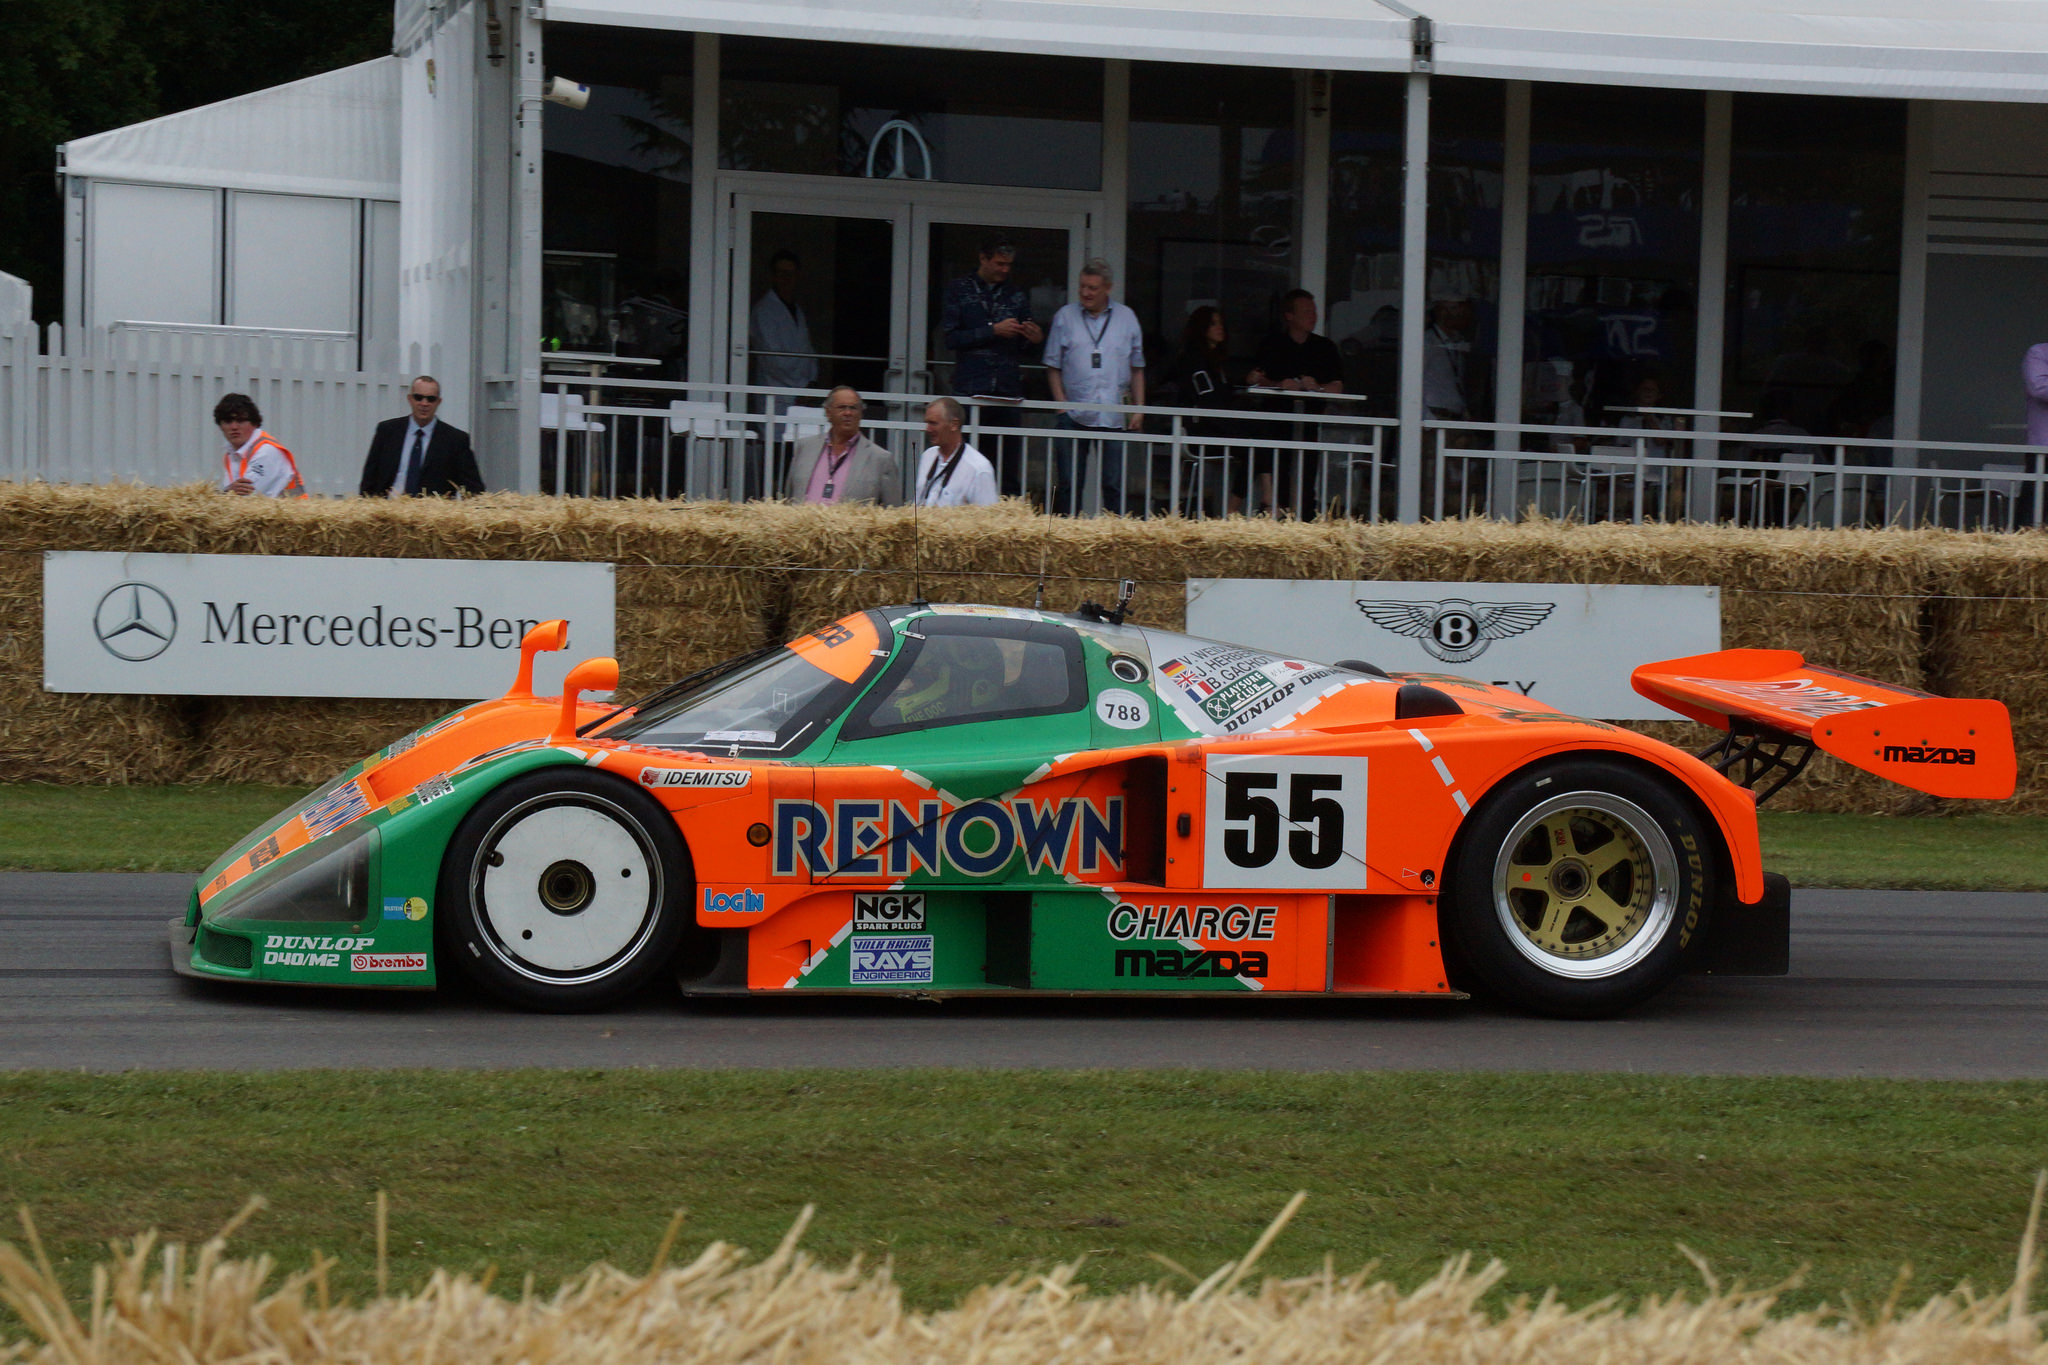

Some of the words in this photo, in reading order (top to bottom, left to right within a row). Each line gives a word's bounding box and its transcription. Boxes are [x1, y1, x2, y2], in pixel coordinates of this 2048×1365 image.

[202, 602, 570, 650] Mercedes-Ben
[1219, 670, 1264, 700] PLAYSURE
[1236, 682, 1262, 701] CLUB
[1105, 703, 1141, 722] 788
[1224, 682, 1295, 733] DUNLOP
[1884, 746, 1975, 765] mazda
[663, 771, 749, 786] IDEMITSU
[1224, 772, 1344, 869] 55
[772, 797, 1124, 877] RENOWN
[1680, 834, 1703, 950] DUNLOP
[857, 896, 922, 921] NGK
[891, 922, 923, 930] PLUGS
[1107, 902, 1278, 942] CHARGE
[264, 935, 375, 951] DUNLOP
[886, 939, 932, 949] RACING
[263, 951, 340, 967] D40/M2
[369, 956, 424, 968] brembo
[853, 951, 932, 970] RAYS
[1115, 949, 1268, 978] mazda
[853, 971, 931, 980] ENGINEERING
